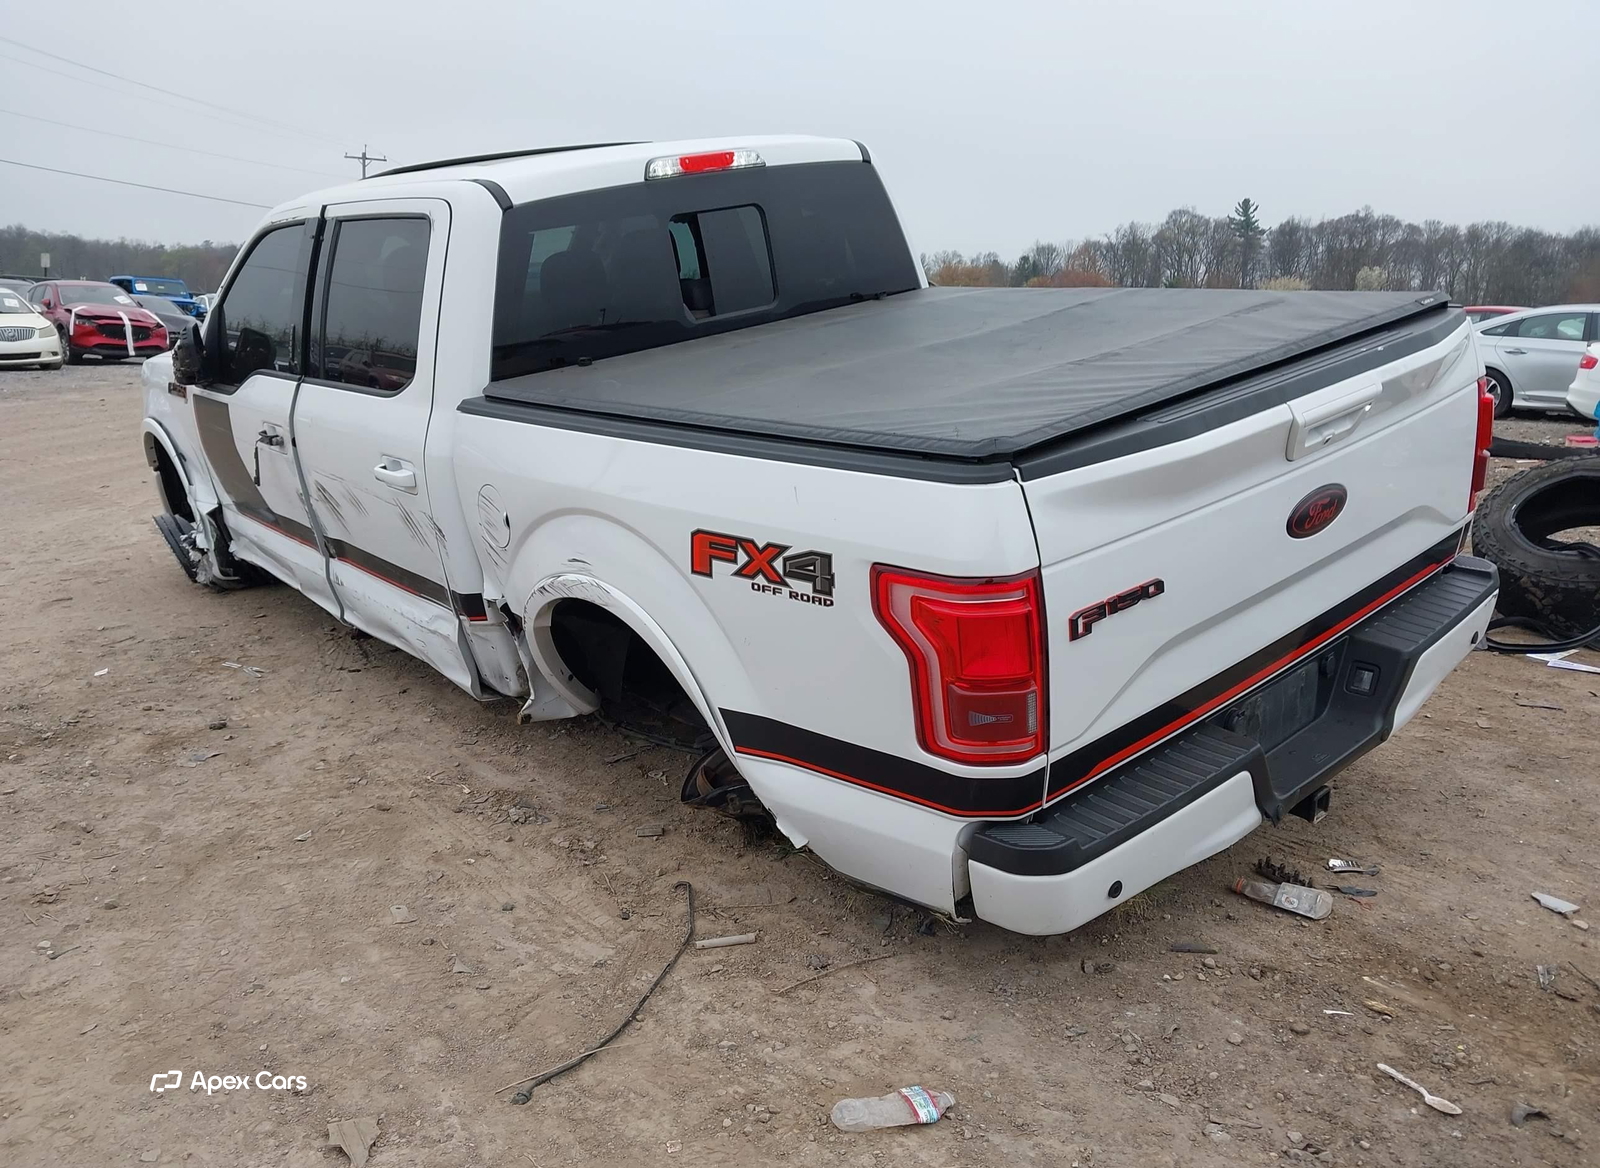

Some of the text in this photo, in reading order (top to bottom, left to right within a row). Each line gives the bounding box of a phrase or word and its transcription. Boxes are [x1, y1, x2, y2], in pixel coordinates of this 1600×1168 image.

[1304, 497, 1338, 530] Ford
[690, 527, 836, 598] FX4
[750, 581, 835, 608] OFF ROAD
